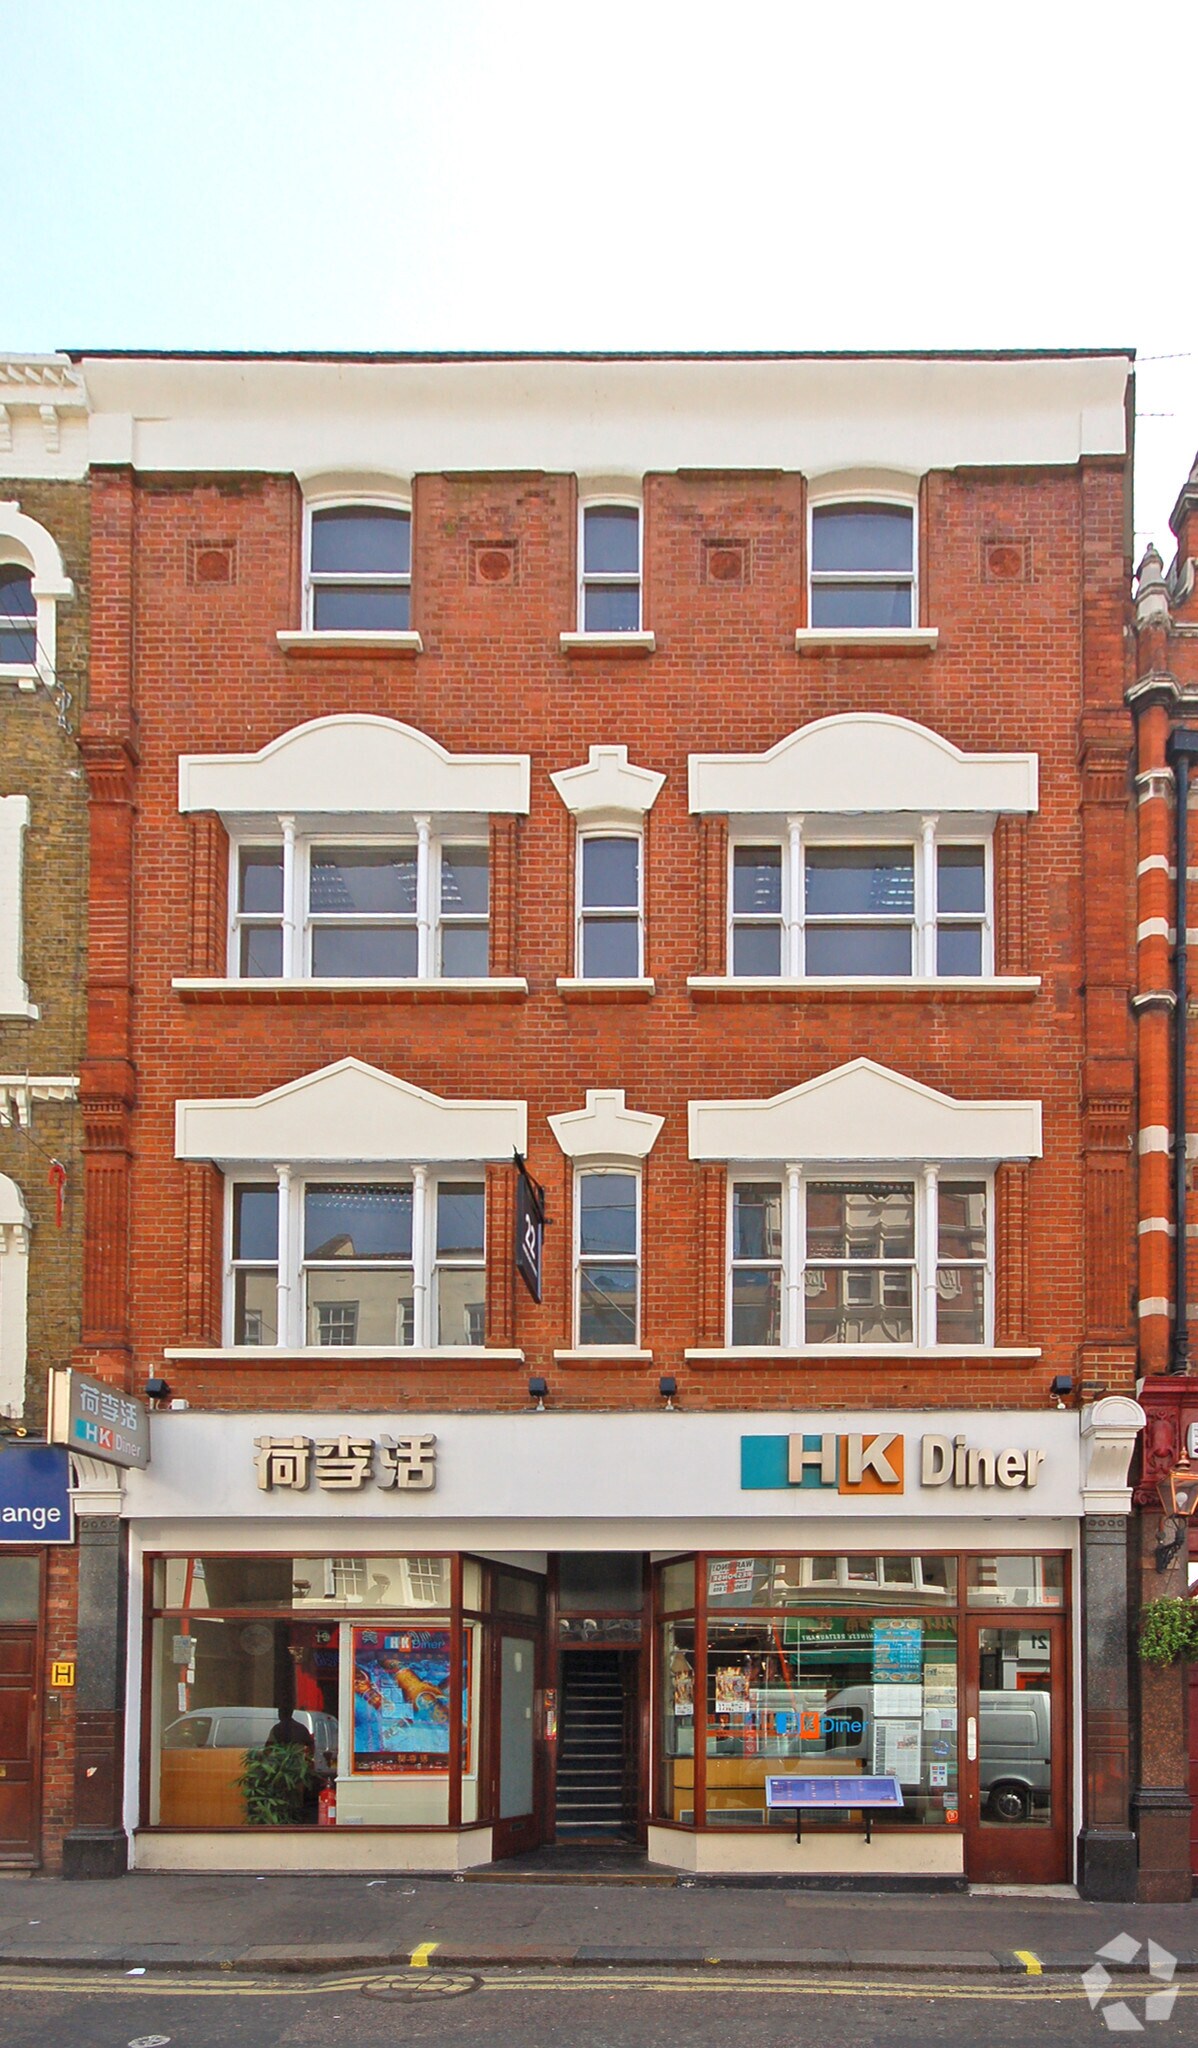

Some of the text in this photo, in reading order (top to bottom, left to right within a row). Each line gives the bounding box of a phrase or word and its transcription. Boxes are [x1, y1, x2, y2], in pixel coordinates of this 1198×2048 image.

[80, 1383, 137, 1431] 荷李活
[85, 1421, 142, 1457] HK Diner
[253, 1434, 438, 1491] 荷李活
[786, 1433, 1045, 1488] HK Diner
[2, 1507, 61, 1530] ange
[55, 1664, 71, 1683] H
[821, 1718, 868, 1733] Diner
